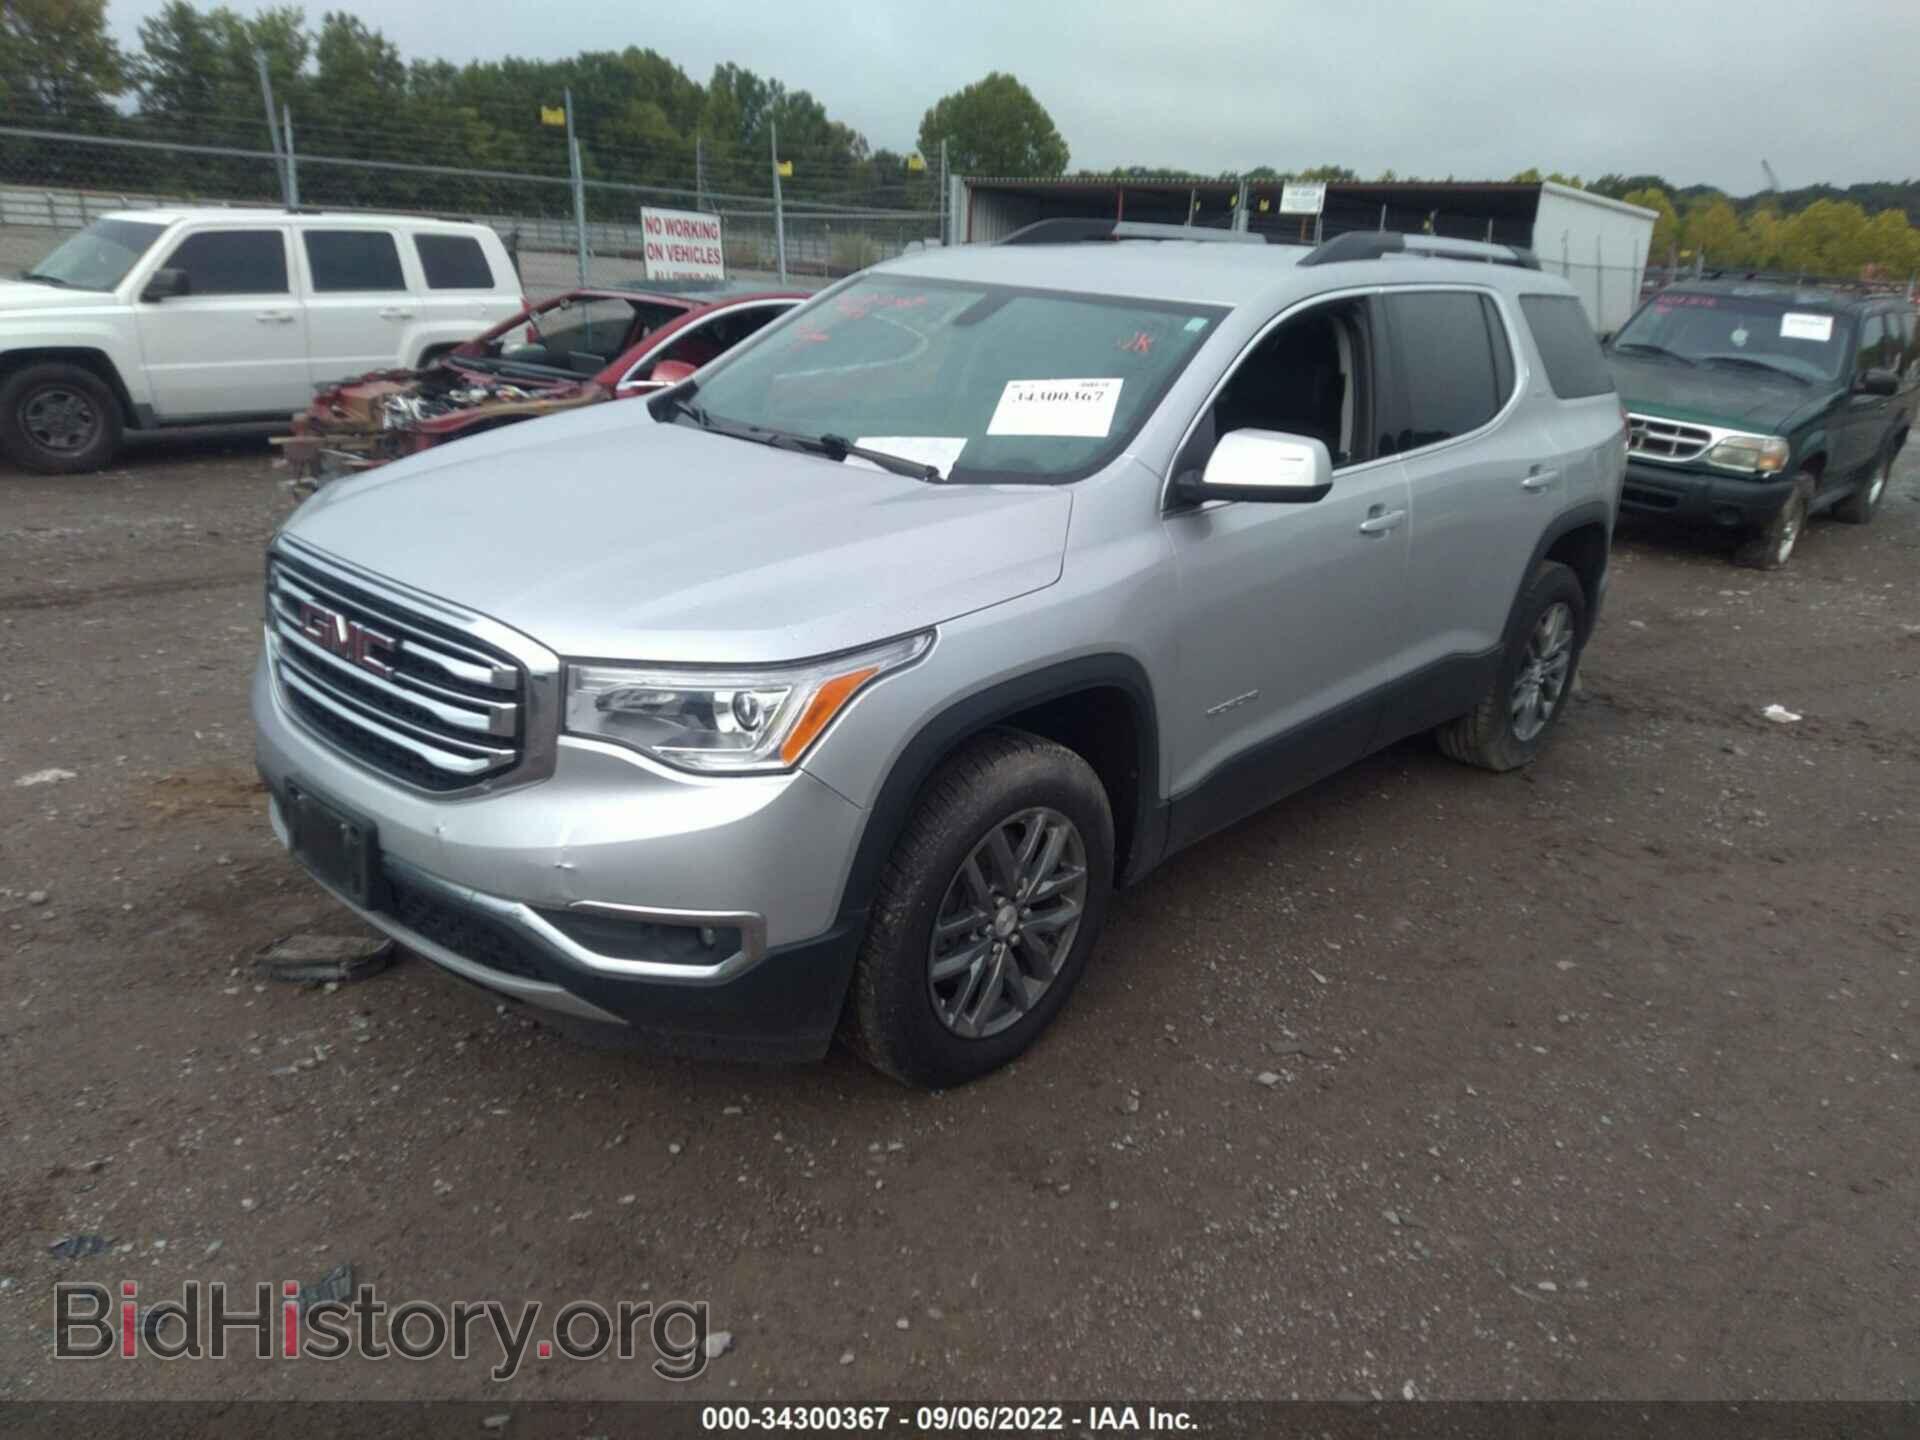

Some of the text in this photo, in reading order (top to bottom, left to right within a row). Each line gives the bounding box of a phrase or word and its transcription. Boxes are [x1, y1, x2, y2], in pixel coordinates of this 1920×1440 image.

[644, 215, 718, 240] NO WORKING
[646, 243, 721, 265] ON VEHICLES
[301, 602, 395, 679] GMC
